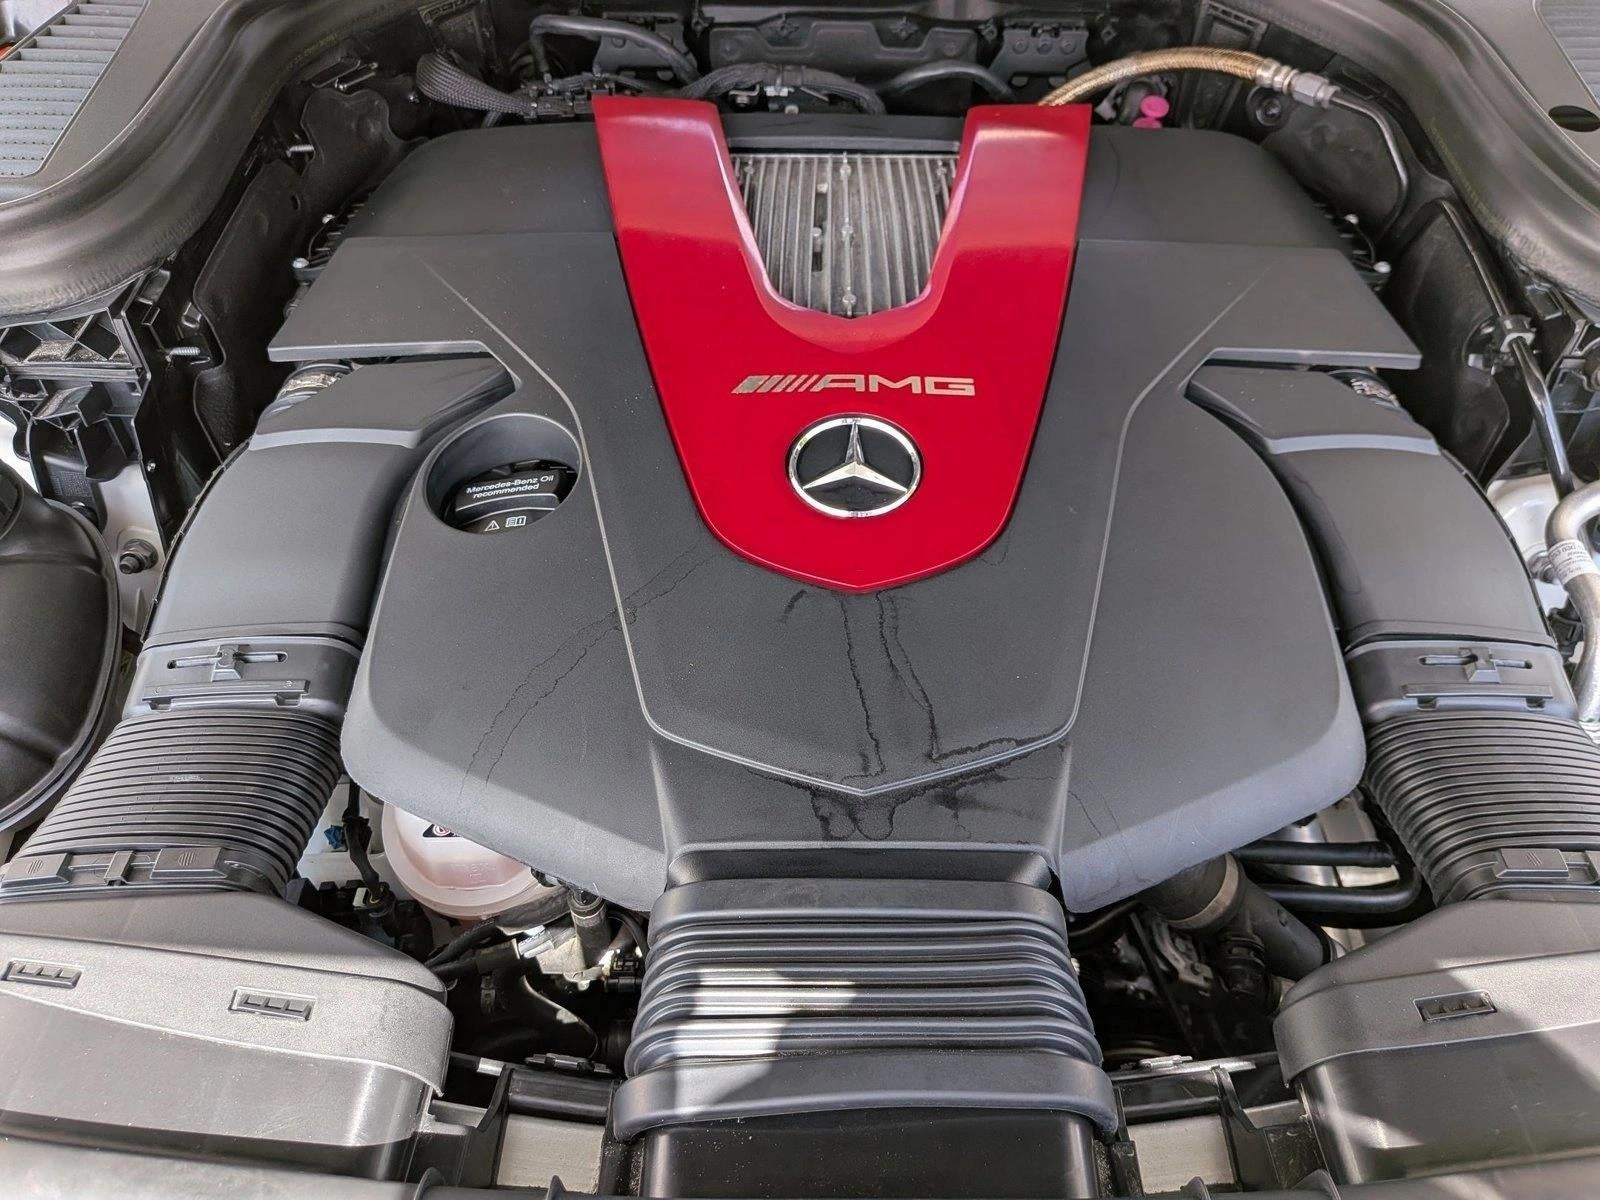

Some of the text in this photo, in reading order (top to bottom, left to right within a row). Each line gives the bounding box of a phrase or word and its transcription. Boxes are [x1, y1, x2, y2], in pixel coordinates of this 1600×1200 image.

[809, 374, 975, 396] AMG
[466, 477, 538, 494] Mercedes-Benz
[473, 483, 539, 499] recommended
